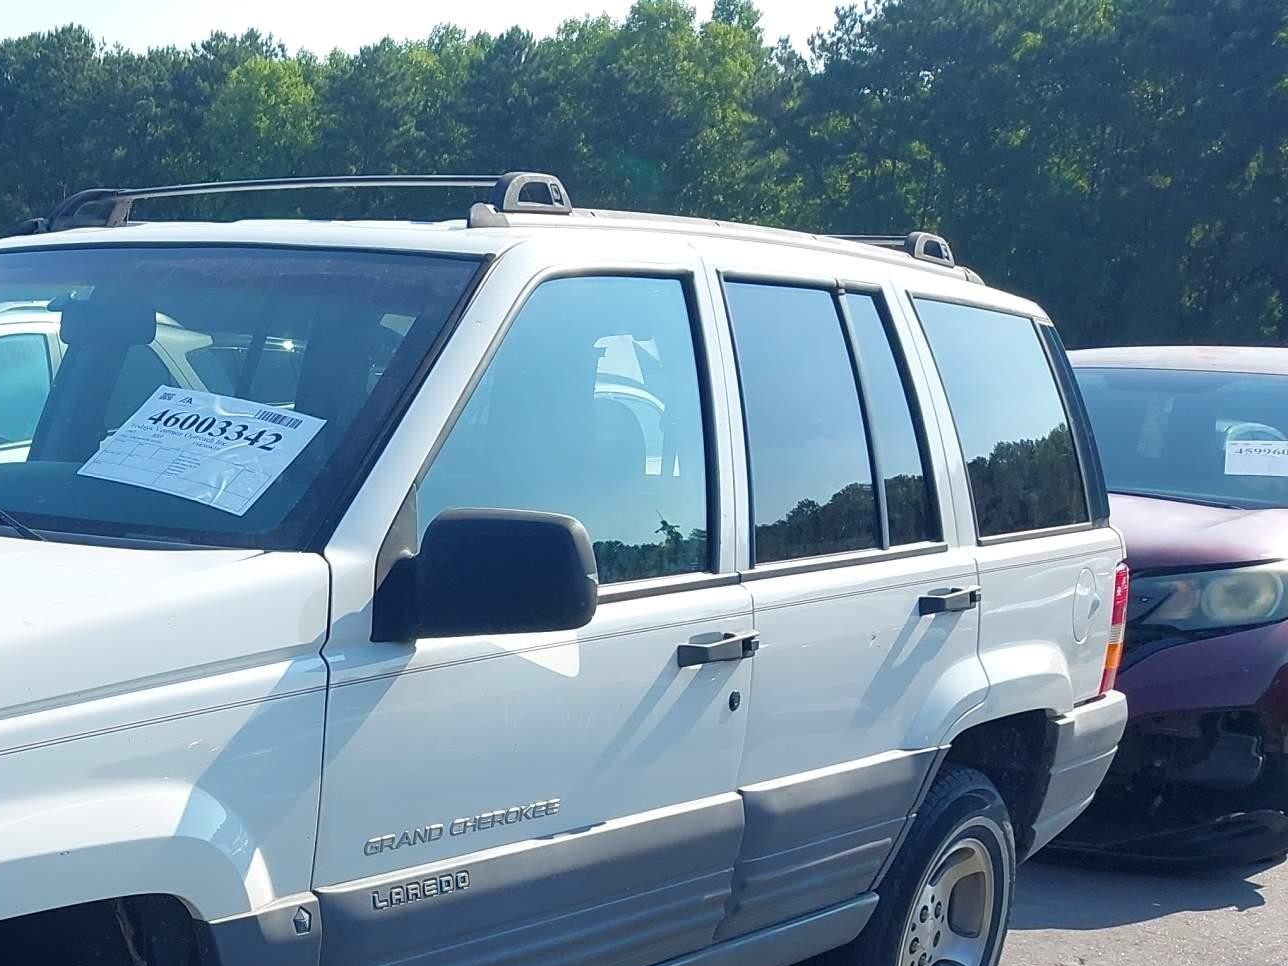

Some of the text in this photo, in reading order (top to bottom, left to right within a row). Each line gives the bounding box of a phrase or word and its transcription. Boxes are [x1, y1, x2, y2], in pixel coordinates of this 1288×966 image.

[148, 409, 283, 451] 46003342
[364, 797, 561, 856] GRAND CHEROKEE
[372, 869, 471, 911] LAREDO
